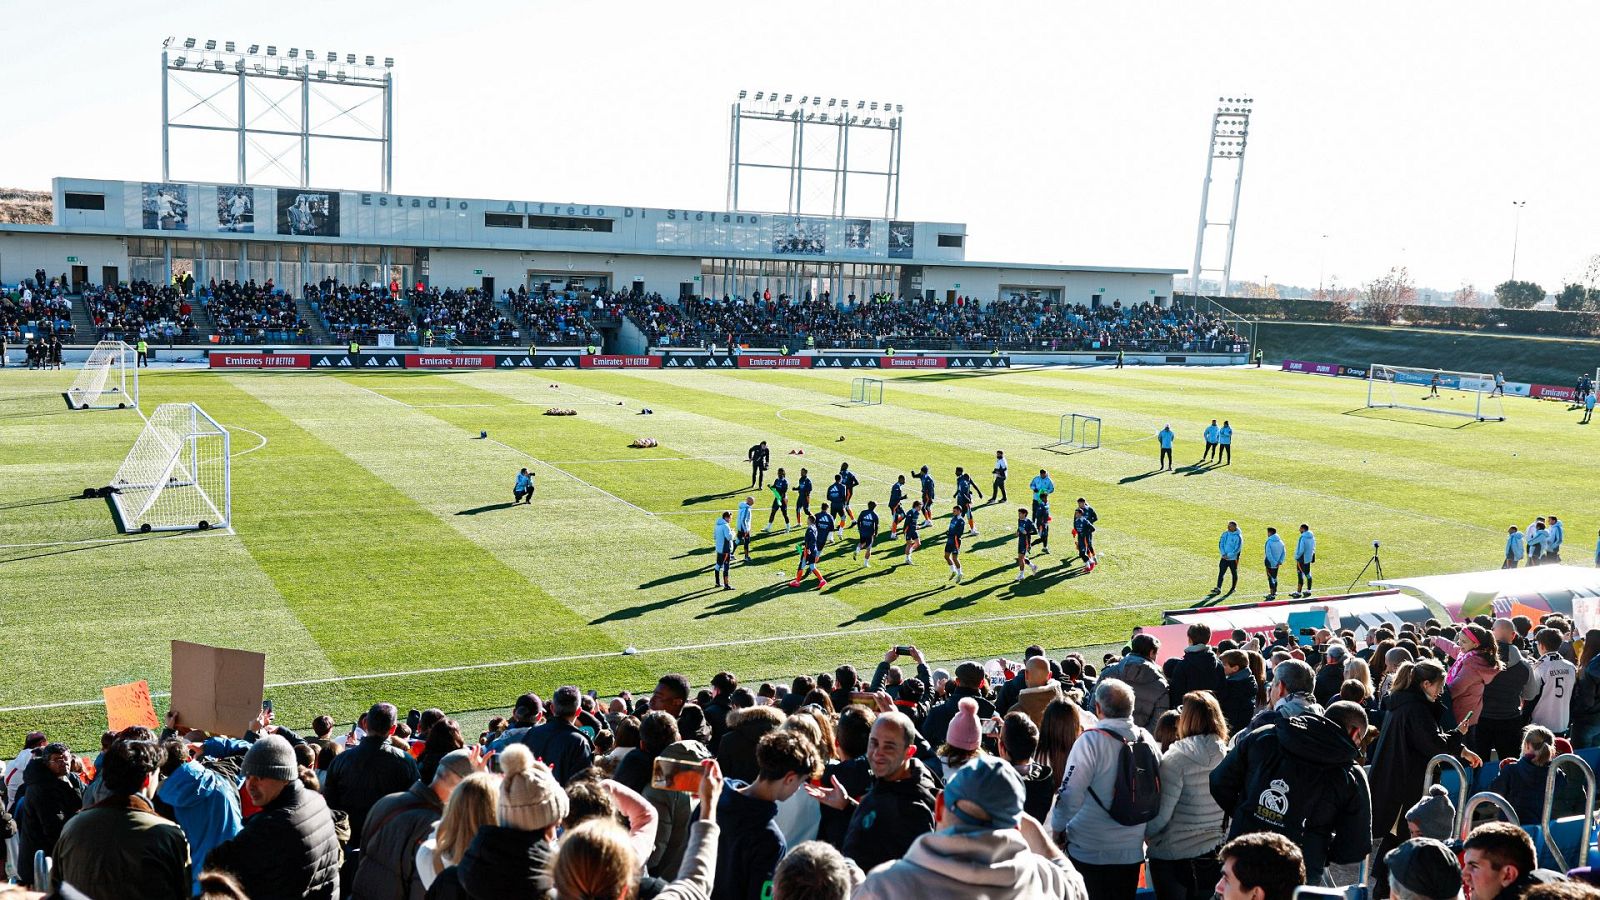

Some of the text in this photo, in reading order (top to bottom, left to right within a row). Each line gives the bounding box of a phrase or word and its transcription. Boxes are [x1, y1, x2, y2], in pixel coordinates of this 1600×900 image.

[361, 193, 758, 224] Estadio Alfredo Di Stéfano
[225, 357, 295, 365] Emirates FLY BETTER
[419, 357, 482, 366] Emirates FLY BETTER
[593, 357, 650, 366] Emirates FLY BETTER
[749, 358, 777, 366] Emirates
[891, 358, 916, 366] Emirates
[1347, 368, 1366, 376] Orange
[1541, 388, 1569, 398] Emirates
[1555, 677, 1564, 698] 5
